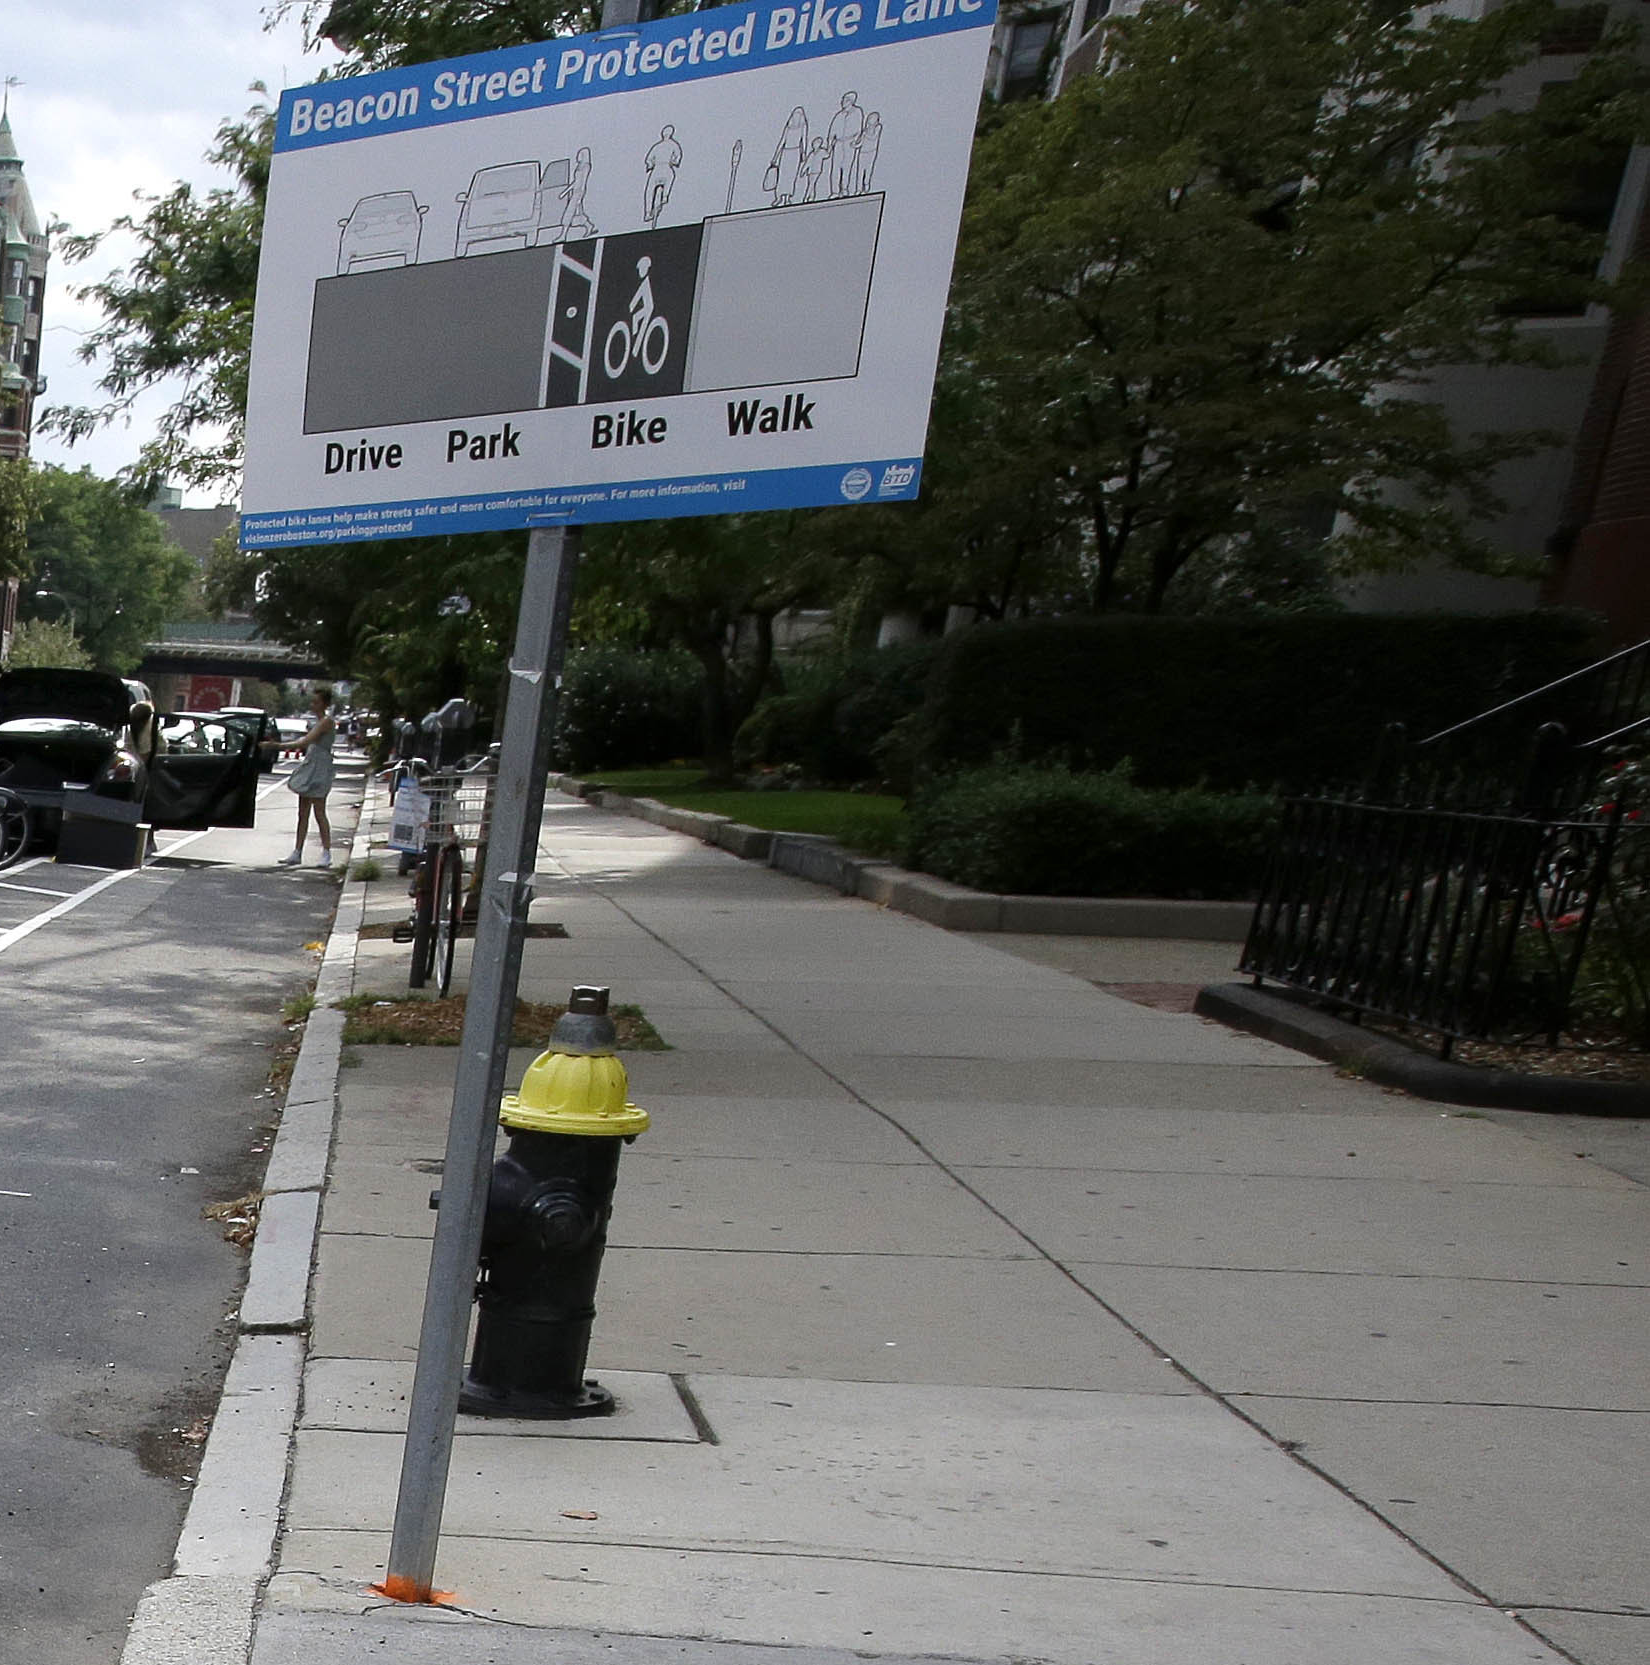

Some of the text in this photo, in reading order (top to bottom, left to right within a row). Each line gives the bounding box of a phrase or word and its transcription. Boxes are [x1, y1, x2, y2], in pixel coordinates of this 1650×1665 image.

[289, 87, 419, 136] Beacon
[431, 56, 547, 112] Street
[556, 12, 756, 89] Protected
[765, 0, 861, 50] Bike
[591, 411, 667, 449] Bike
[726, 394, 816, 436] Walk
[324, 439, 403, 475] Drive
[446, 423, 521, 463] Park
[883, 473, 910, 485] BTD
[245, 480, 746, 531] Protected bike lanes help make streets safer and more comfortable for everyone. For more information, visit
